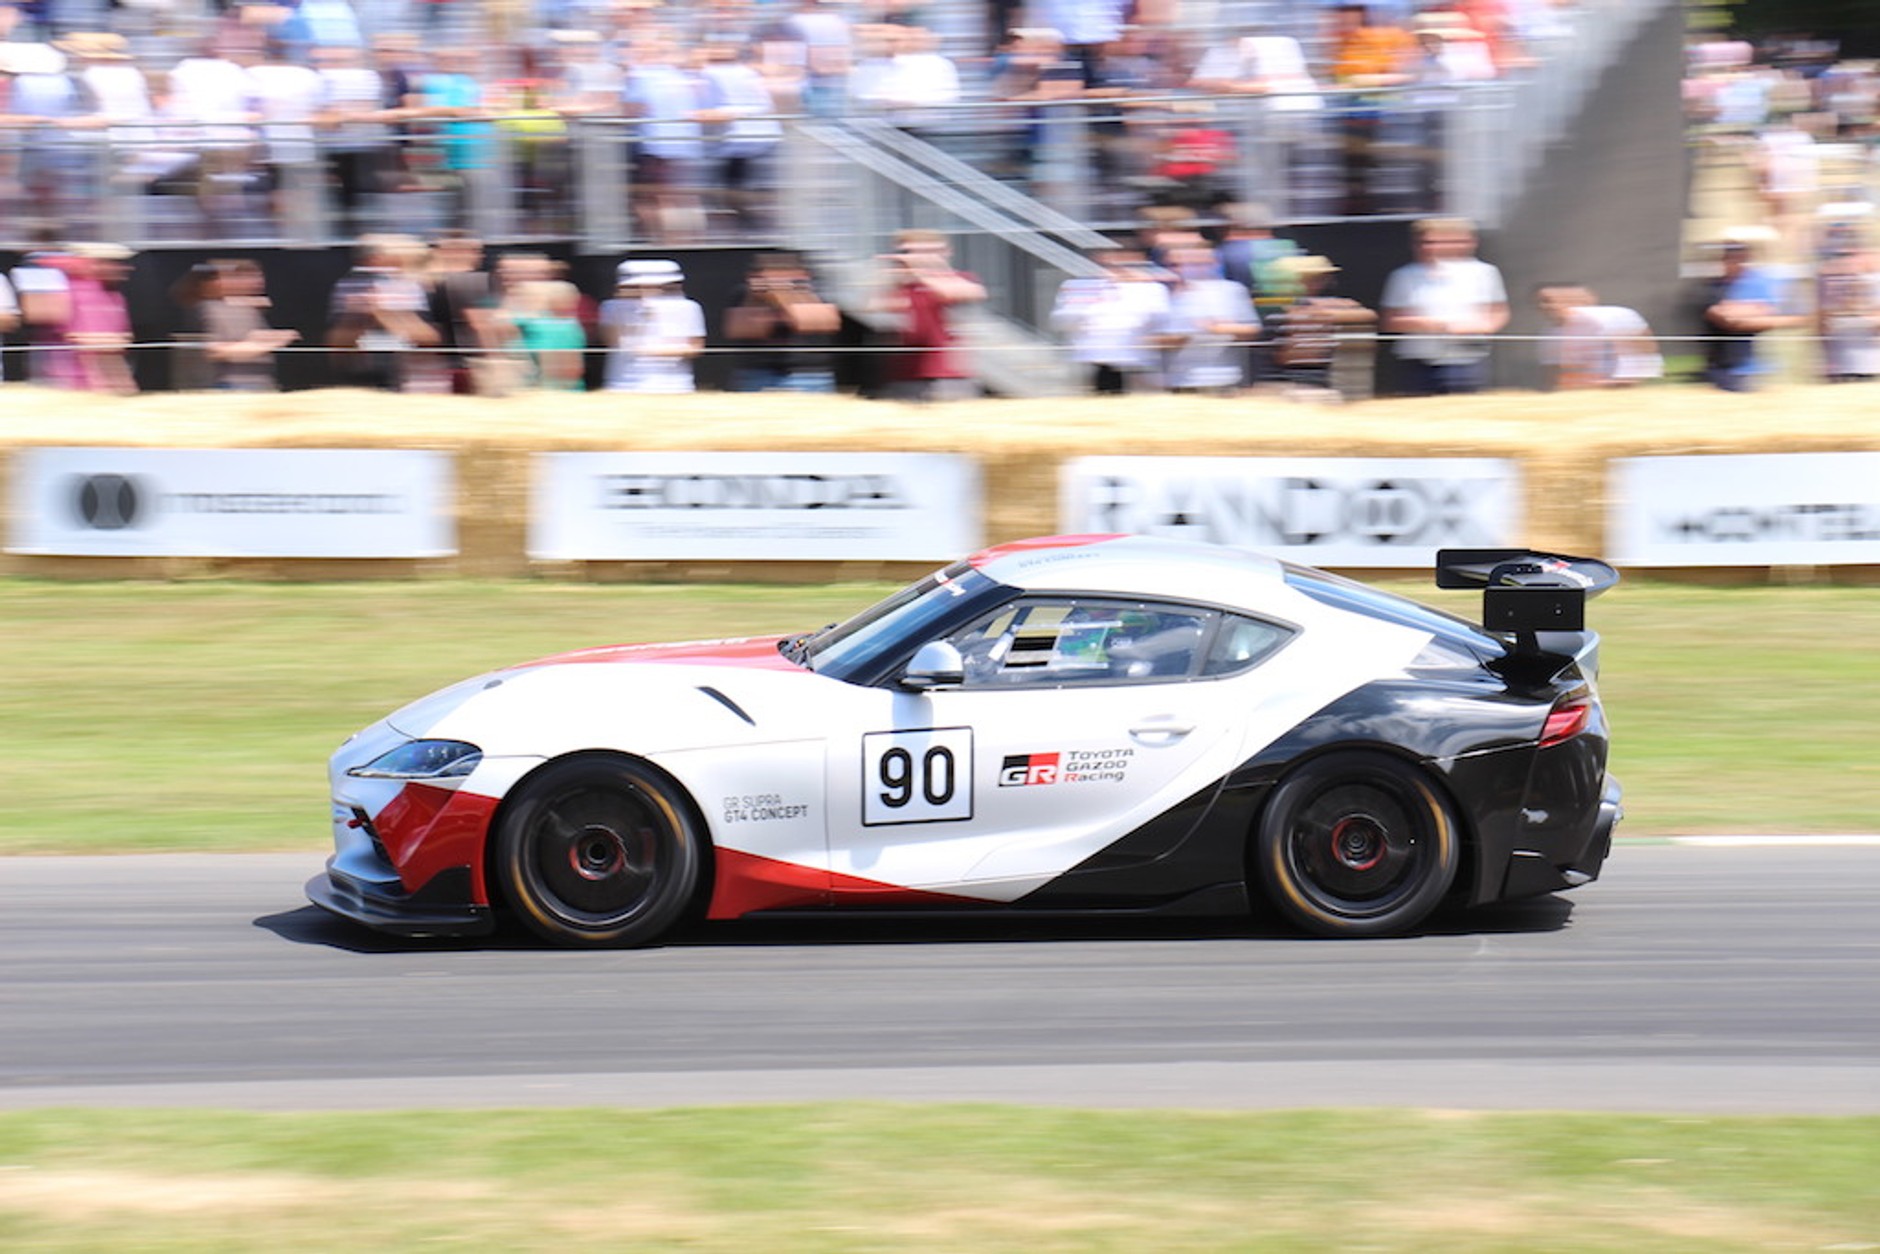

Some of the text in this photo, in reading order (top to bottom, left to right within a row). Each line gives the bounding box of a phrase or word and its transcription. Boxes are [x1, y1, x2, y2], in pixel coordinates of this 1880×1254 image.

[1068, 749, 1134, 760] TOYOTA
[1066, 760, 1127, 772] GAZOO
[880, 745, 954, 808] 90
[1000, 765, 1057, 786] GR
[1064, 771, 1125, 783] Racing
[723, 794, 781, 810] GR SUPRA
[724, 804, 808, 823] GT4 CONCEPT
